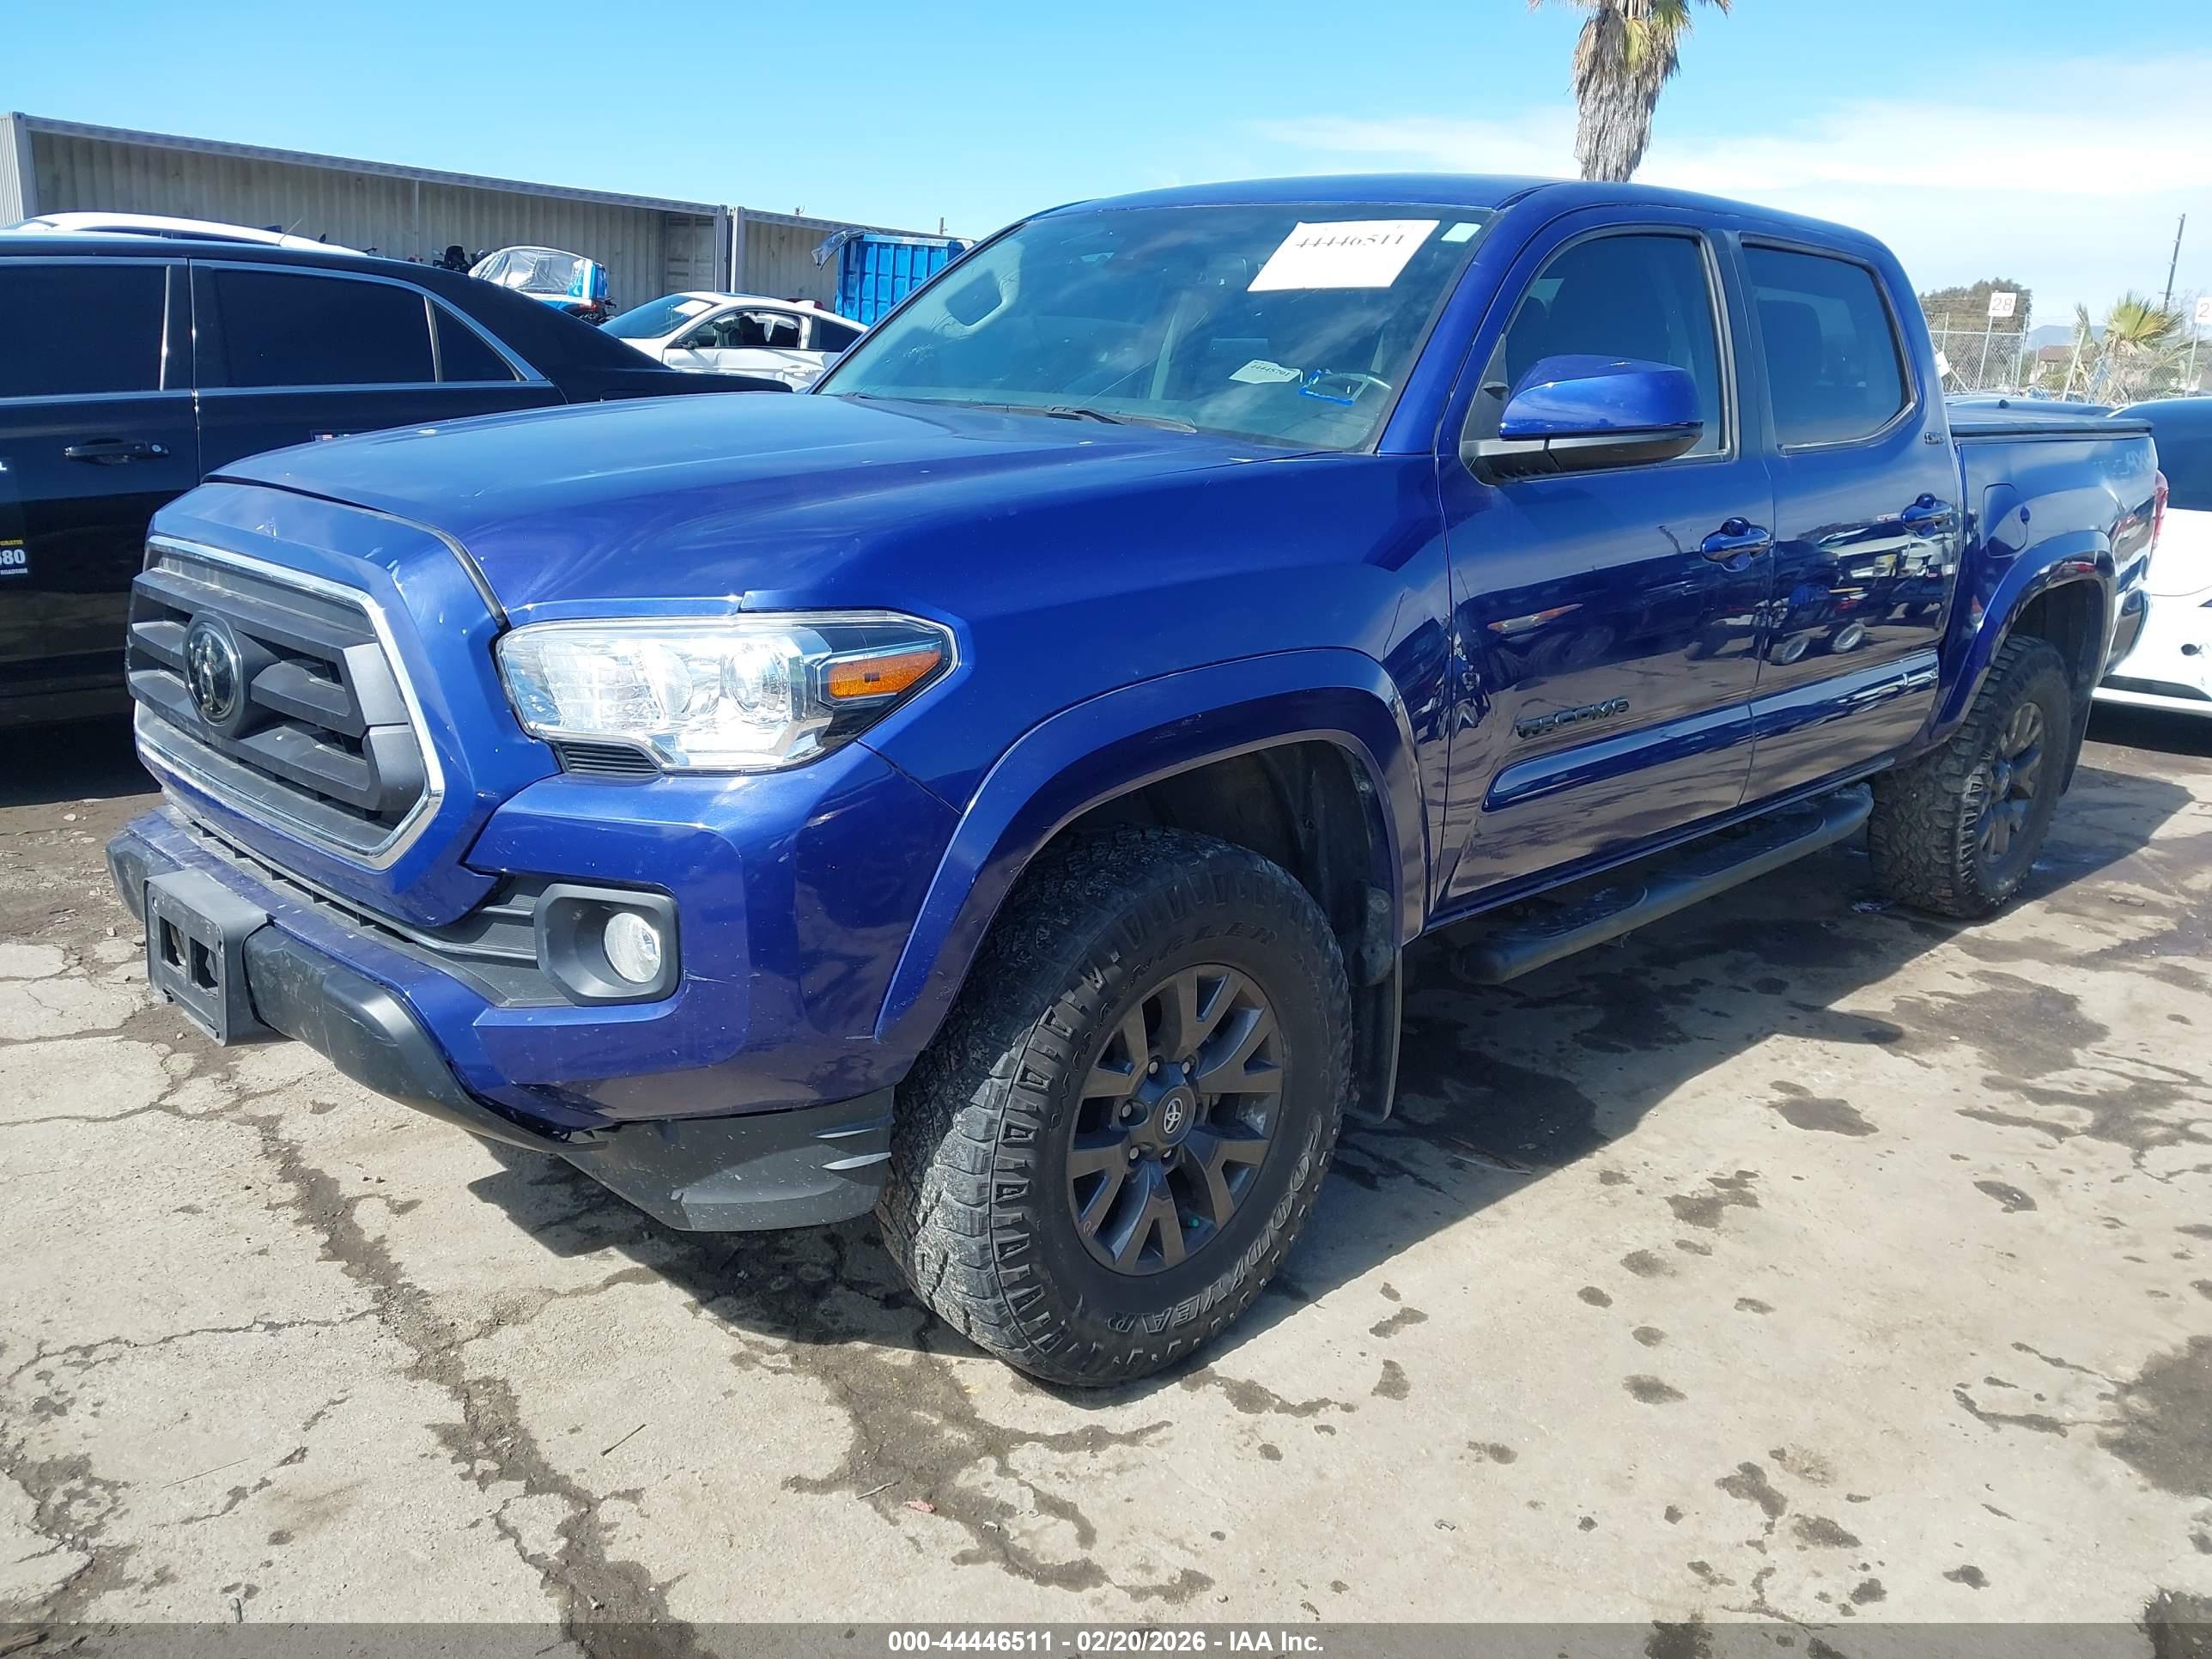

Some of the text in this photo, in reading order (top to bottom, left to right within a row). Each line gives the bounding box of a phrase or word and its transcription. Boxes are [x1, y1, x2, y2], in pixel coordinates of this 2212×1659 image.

[1991, 297, 2013, 311] 28
[2197, 302, 2212, 318] 2
[0, 549, 26, 566] 80
[1514, 697, 1630, 738] TACOMA
[1106, 1115, 1323, 1334] GOODYEAR
